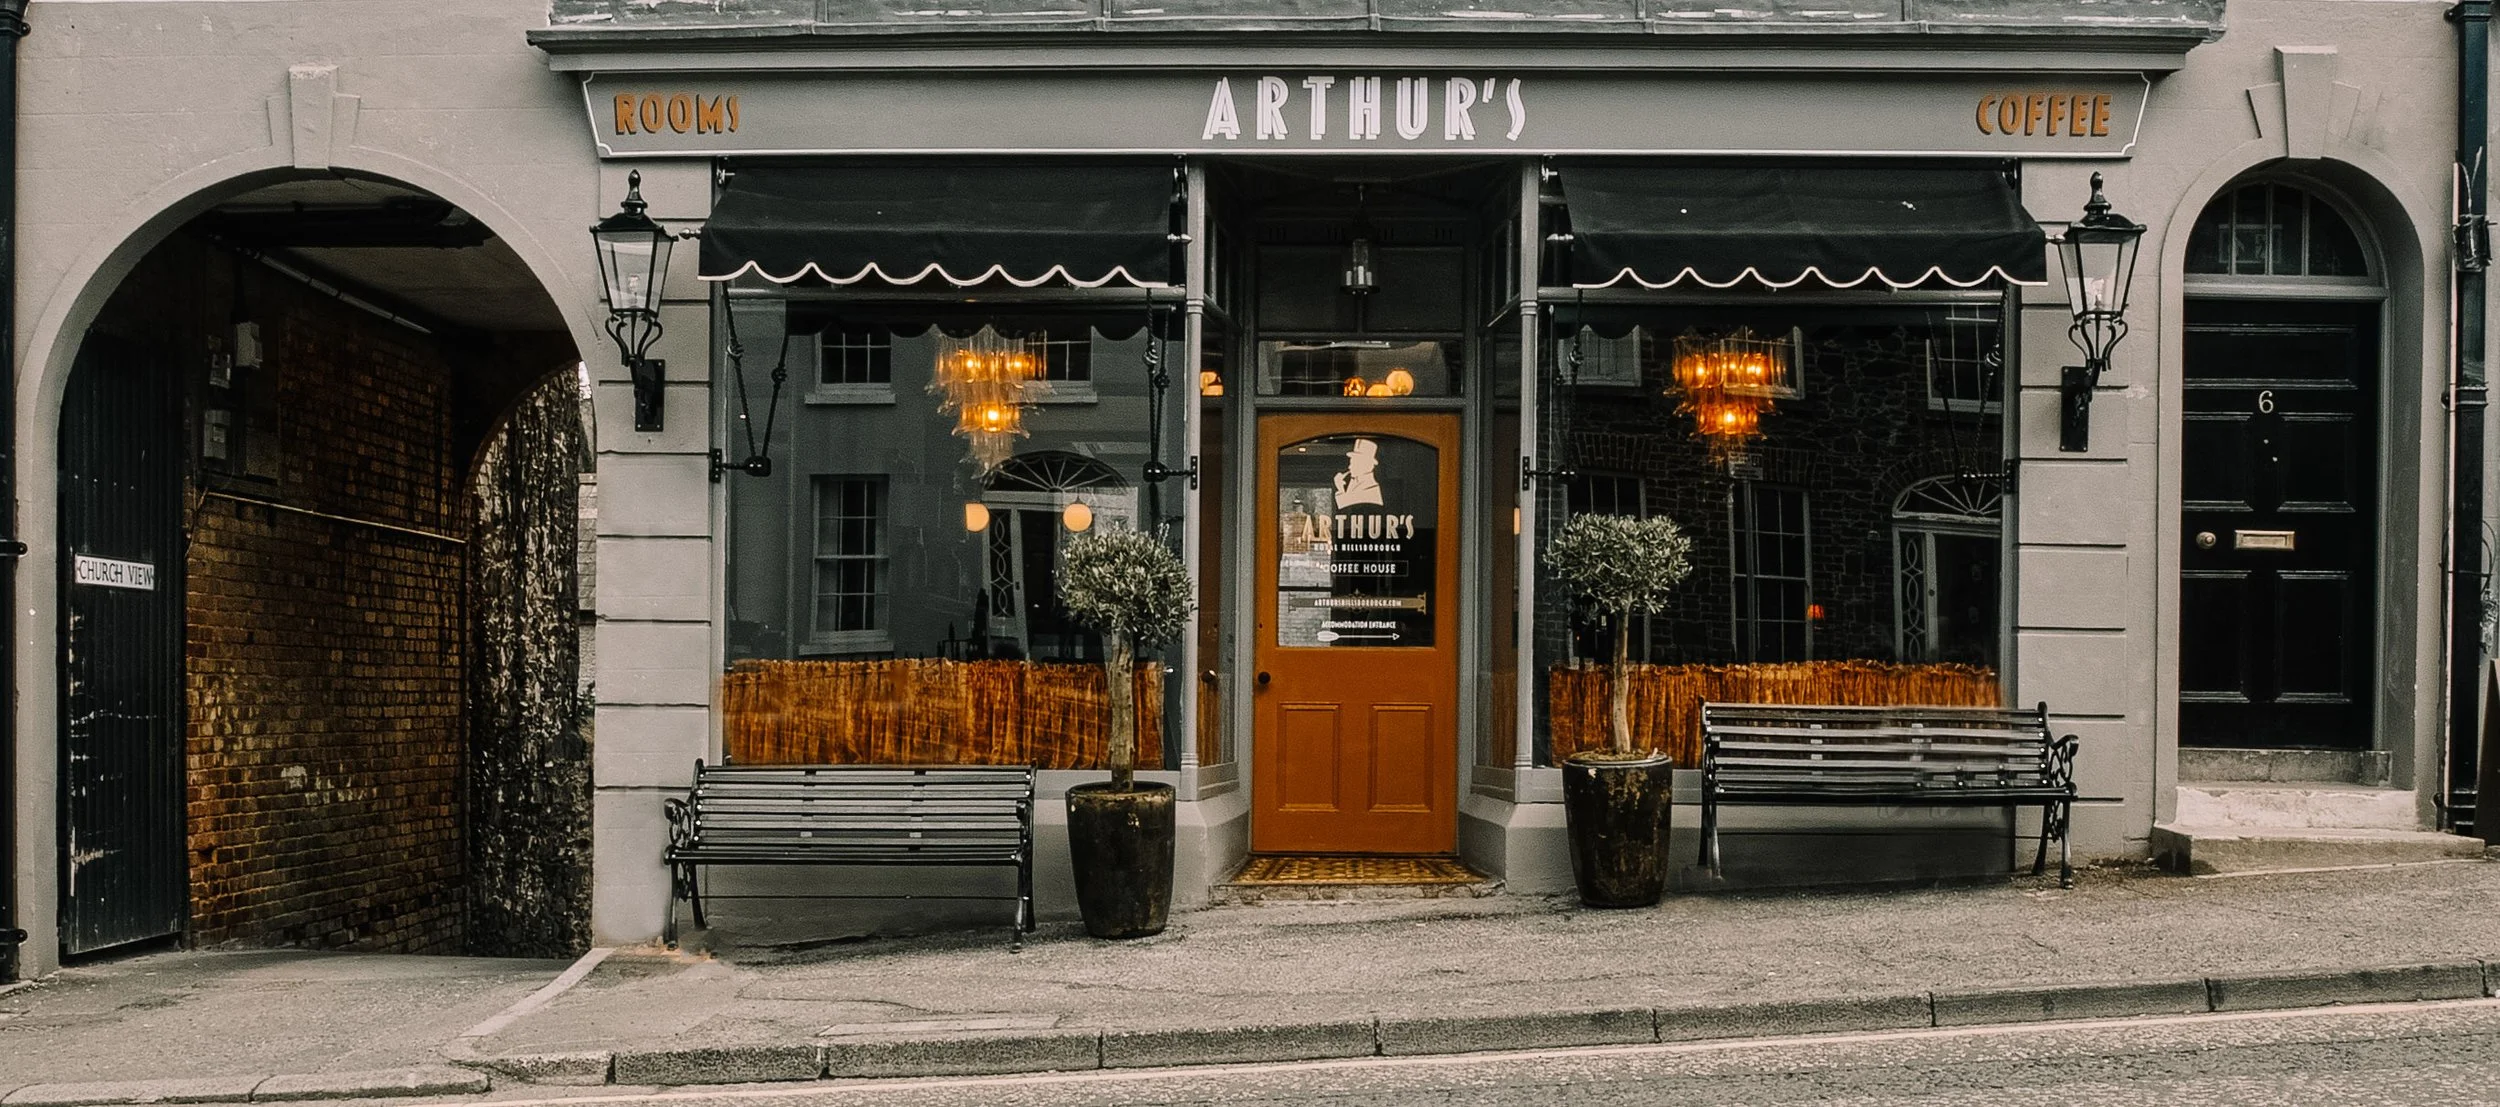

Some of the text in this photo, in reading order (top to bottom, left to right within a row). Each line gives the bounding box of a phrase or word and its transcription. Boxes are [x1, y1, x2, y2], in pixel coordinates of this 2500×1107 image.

[613, 93, 740, 135] ROOMS
[1201, 76, 1527, 141] ARTHUR'S
[1975, 93, 2112, 137] COFFEE
[2258, 390, 2274, 414] 6
[1301, 514, 1415, 540] ARTHUR'S
[79, 560, 153, 586] CHURCH VIEW
[1323, 563, 1396, 574] COFFEE HOUSE
